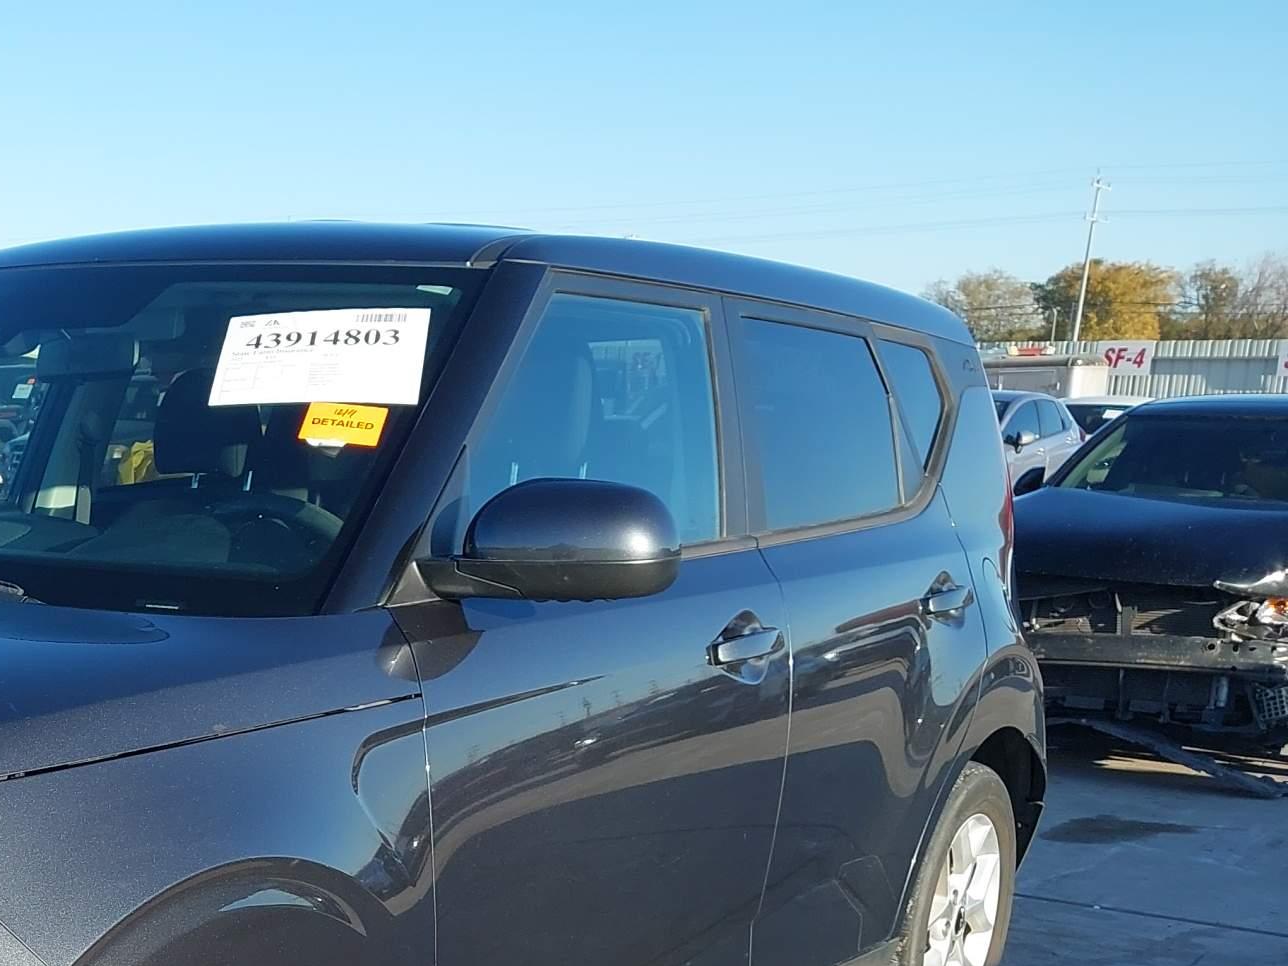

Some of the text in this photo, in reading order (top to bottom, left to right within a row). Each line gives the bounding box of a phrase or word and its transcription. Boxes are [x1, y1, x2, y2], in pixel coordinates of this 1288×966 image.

[245, 328, 401, 349] 43914803
[1104, 347, 1147, 369] SF-4
[311, 417, 375, 430] DETAILED
